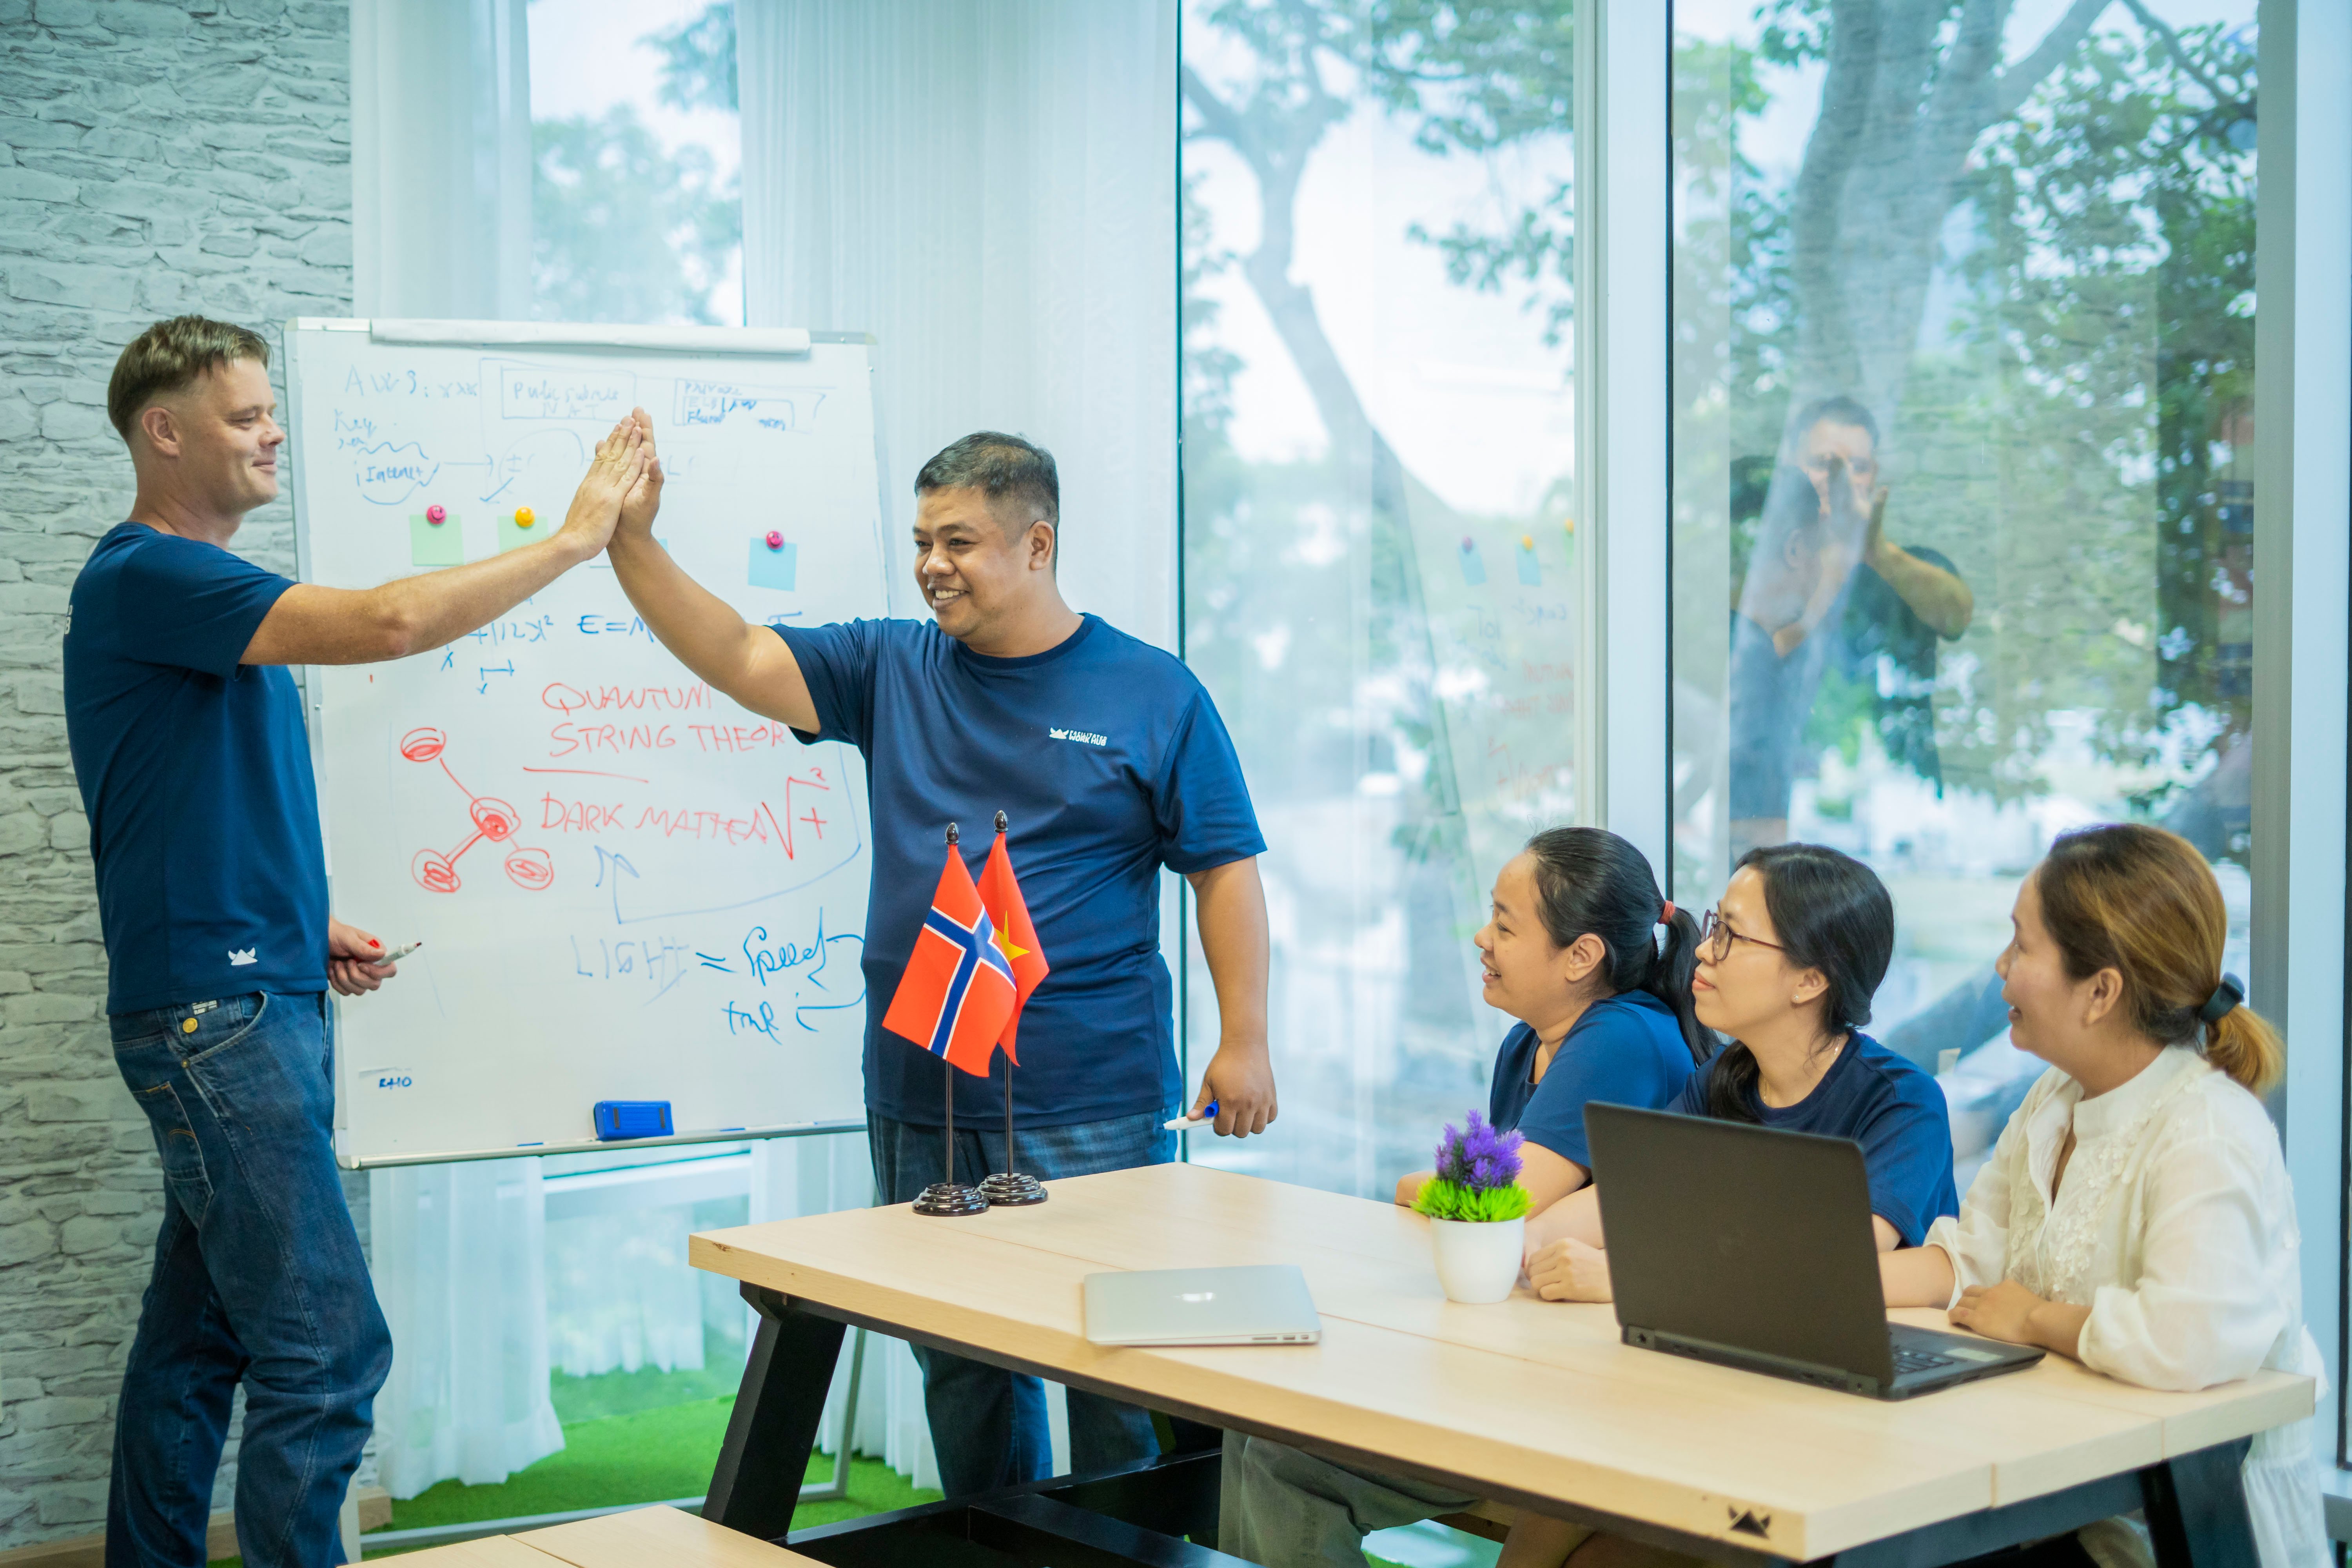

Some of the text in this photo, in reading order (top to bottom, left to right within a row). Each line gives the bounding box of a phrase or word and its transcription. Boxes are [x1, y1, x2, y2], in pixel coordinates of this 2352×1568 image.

[334, 408, 377, 438] Key
[542, 680, 711, 717] QUANTUM
[549, 722, 676, 757] STRING
[1069, 735, 1107, 746] WORK HUB
[541, 791, 623, 833] DARK
[570, 935, 689, 989] LIGHT
